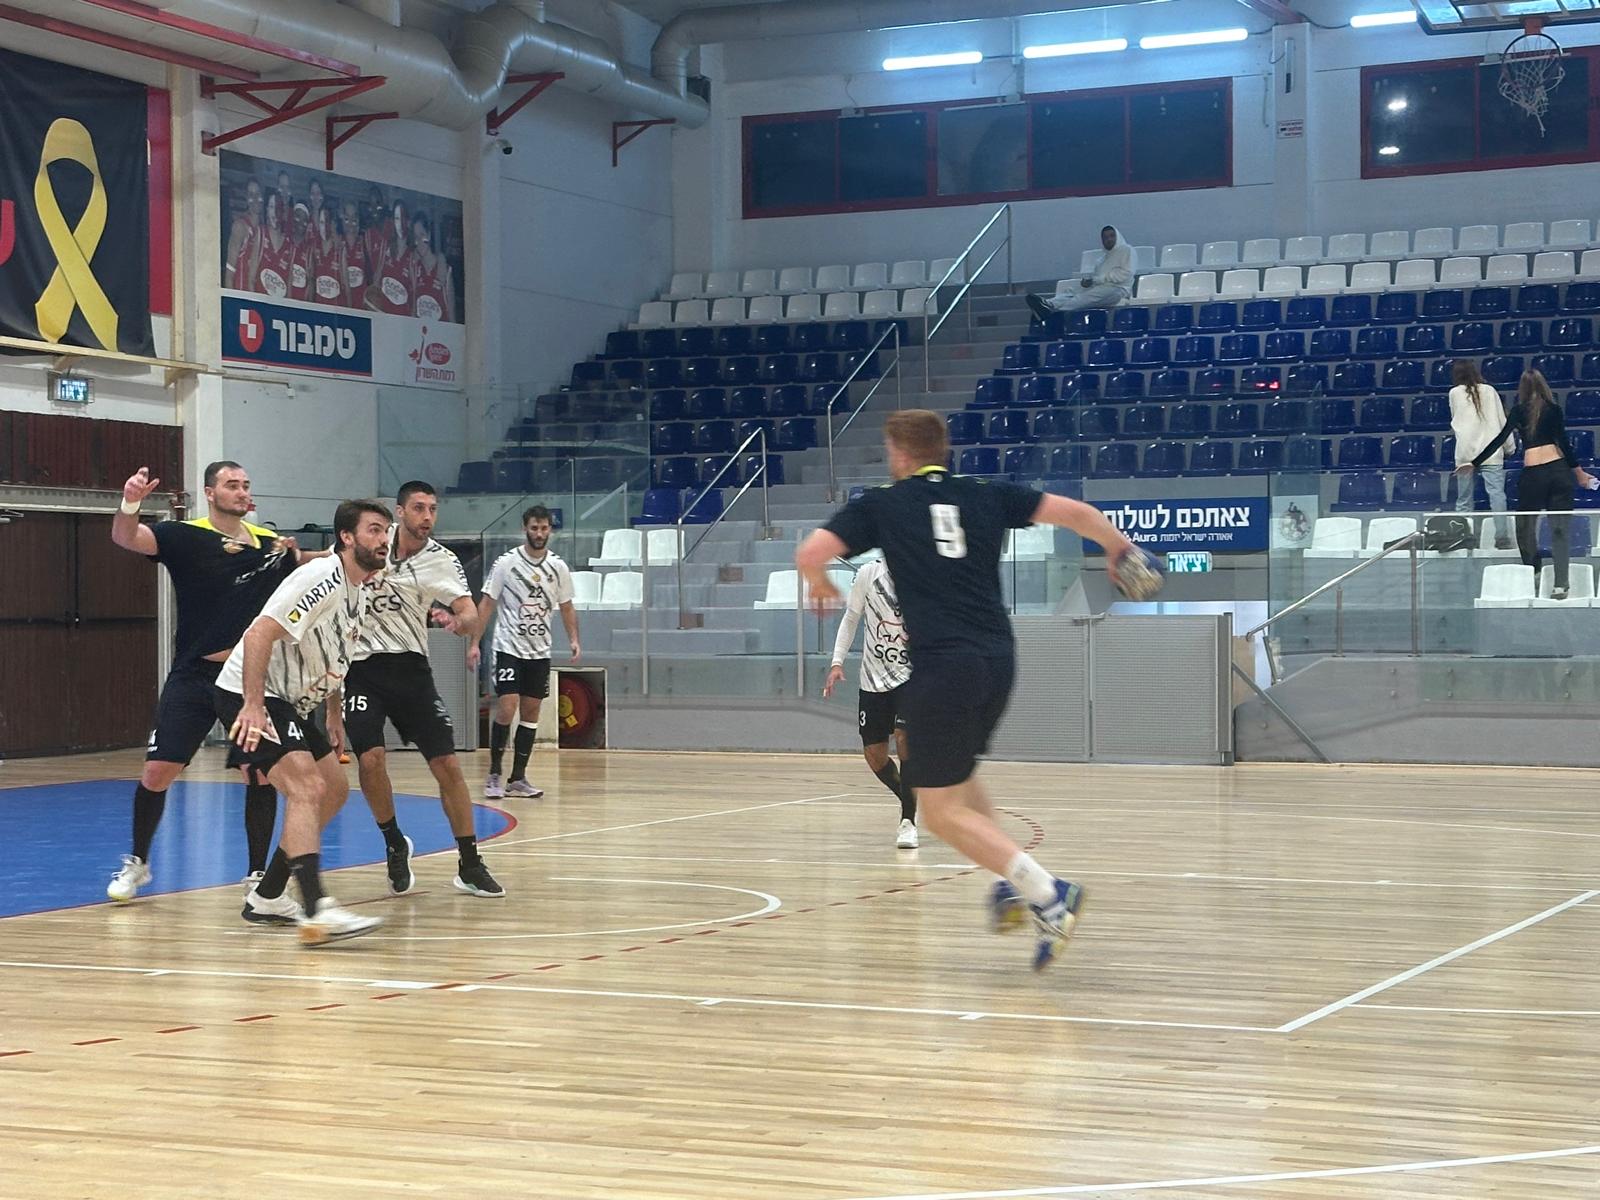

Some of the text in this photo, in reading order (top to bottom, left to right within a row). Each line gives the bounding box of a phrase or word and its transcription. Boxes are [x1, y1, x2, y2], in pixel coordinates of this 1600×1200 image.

[272, 318, 356, 359] טמבור
[1176, 507, 1250, 529] צאתכם
[929, 503, 968, 559] 9
[1132, 531, 1158, 543] Aura
[1169, 553, 1206, 572] יציאה
[296, 578, 337, 613] VARTA
[528, 585, 544, 598] 22
[518, 623, 547, 636] SGS
[873, 643, 910, 665] SGS
[498, 668, 515, 681] 22
[348, 695, 368, 712] 15
[288, 721, 304, 741] 4
